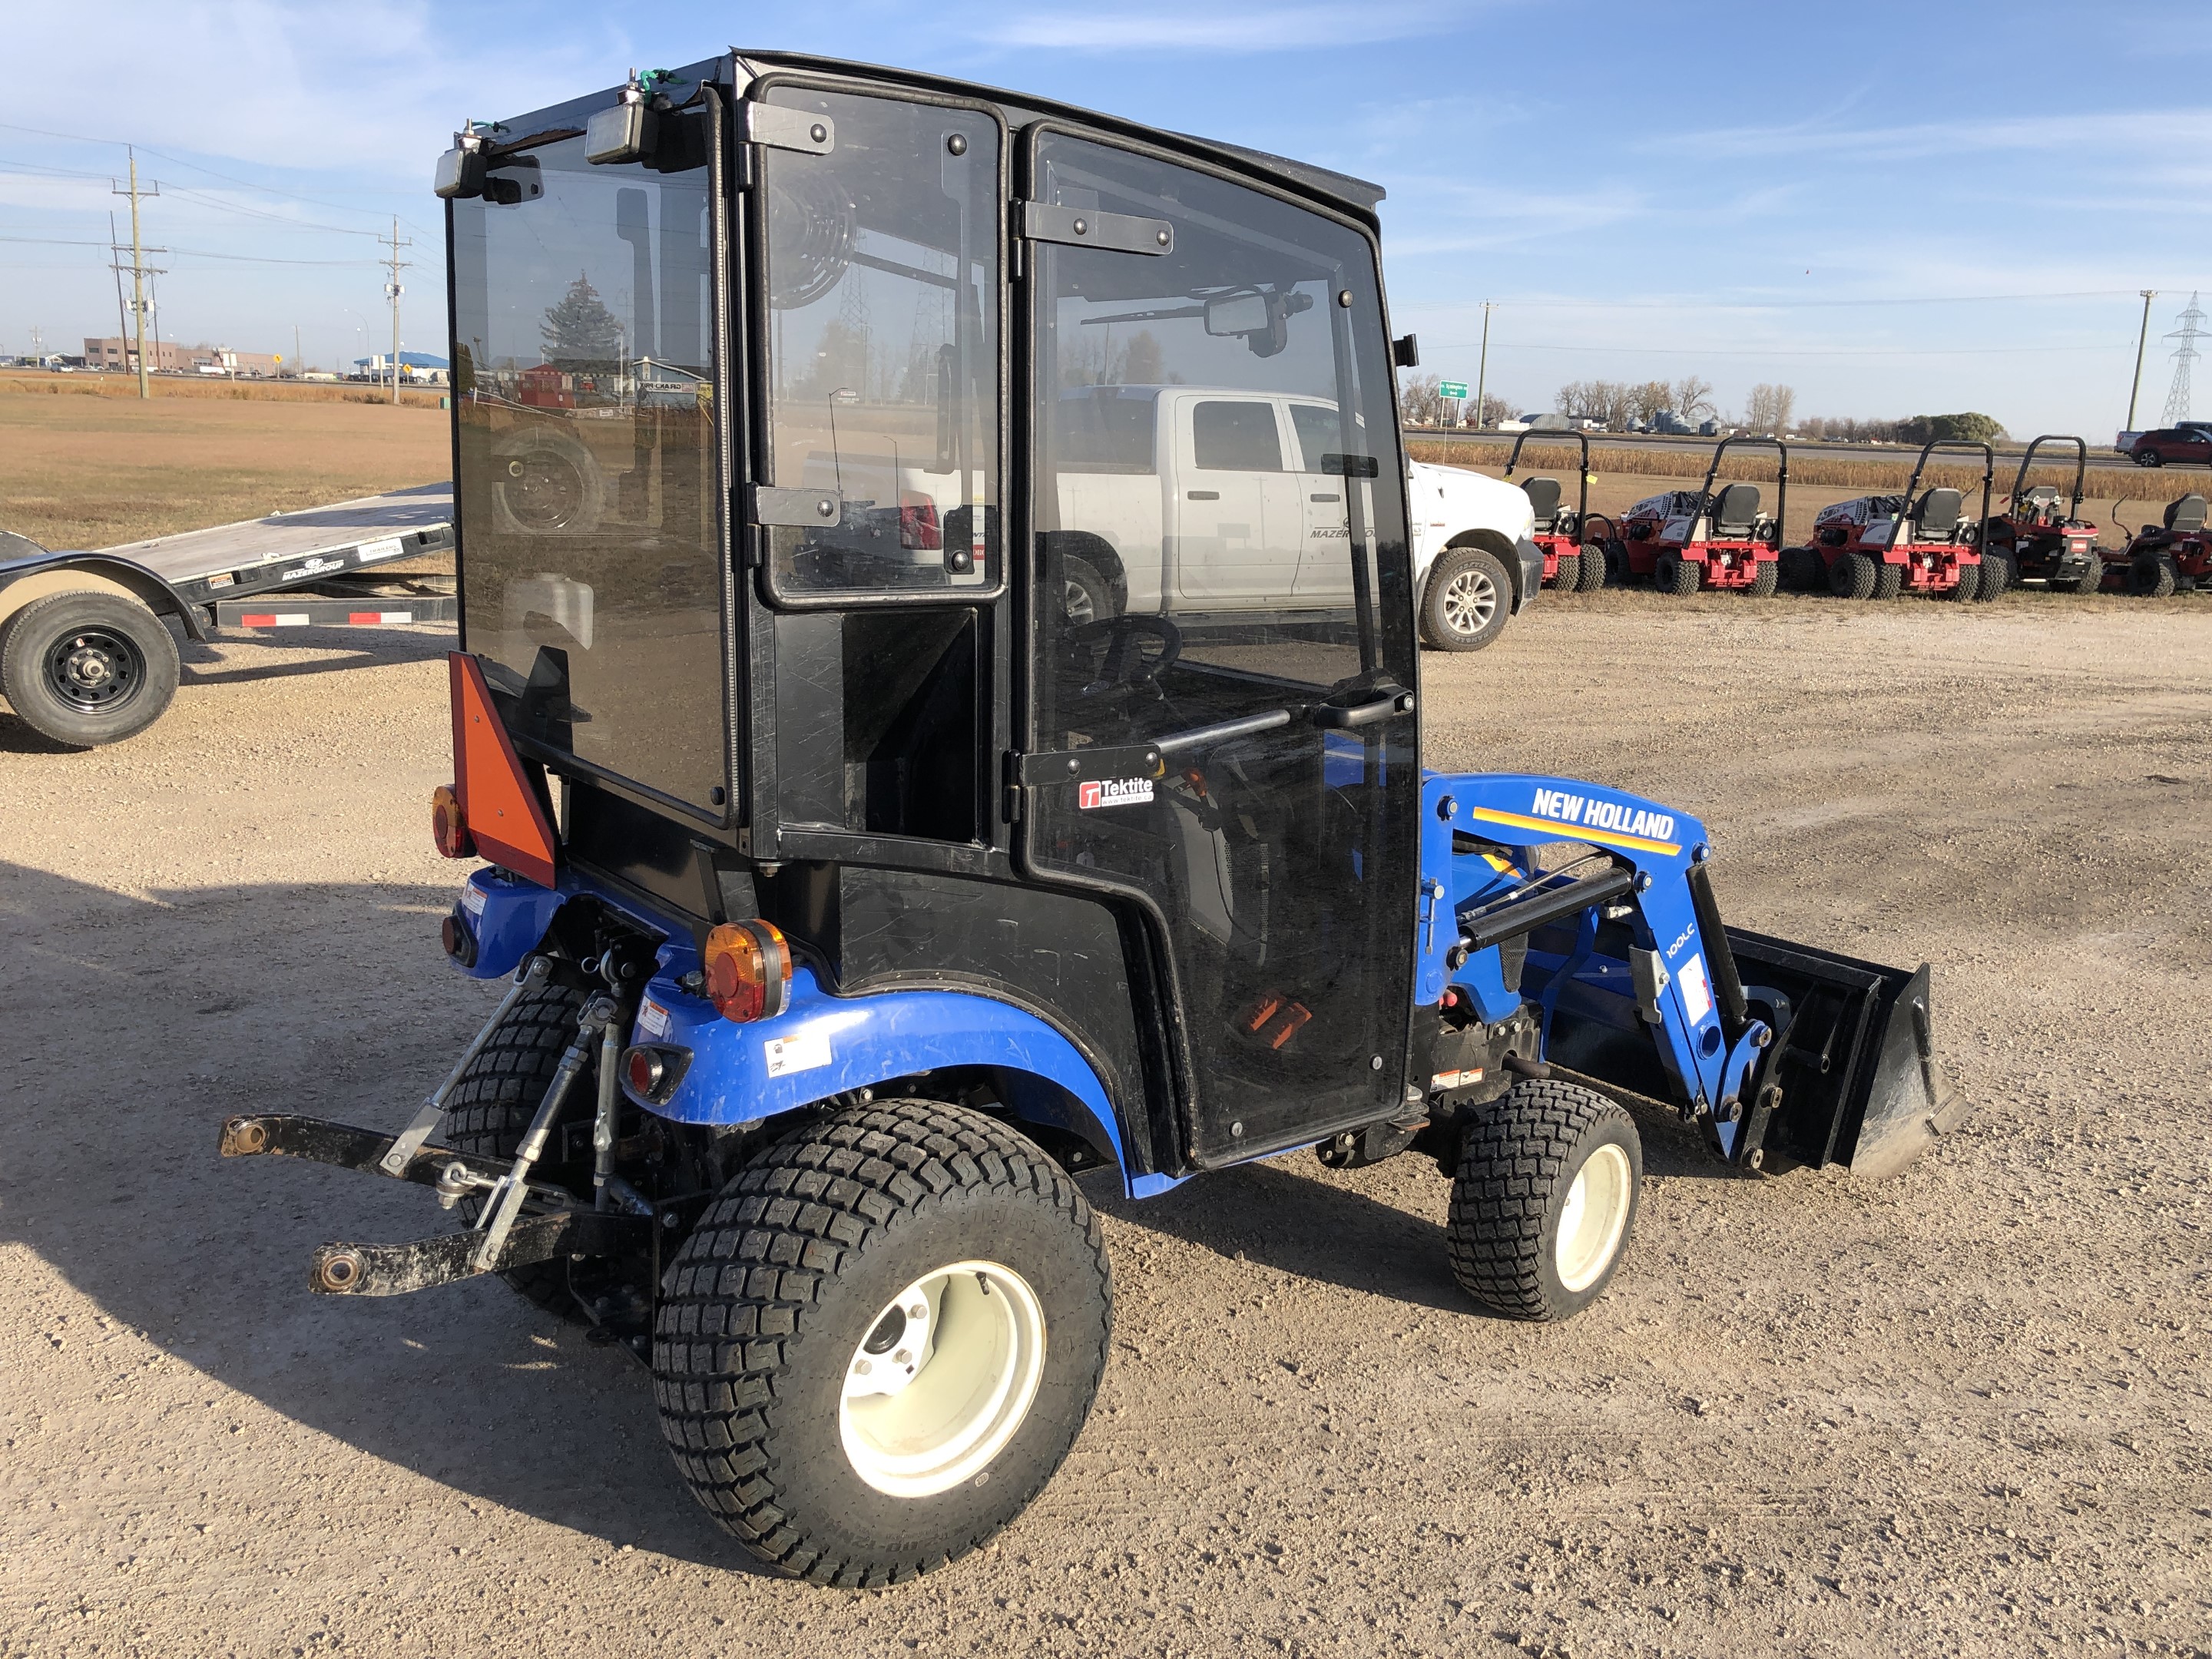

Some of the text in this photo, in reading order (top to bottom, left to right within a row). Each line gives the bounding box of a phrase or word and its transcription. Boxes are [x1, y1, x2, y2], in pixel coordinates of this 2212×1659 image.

[282, 561, 345, 581] MAZERGROUP
[1101, 777, 1153, 796] Tektite
[1532, 787, 1674, 840] NEW HOLLAND
[1666, 922, 1695, 959] 100LC
